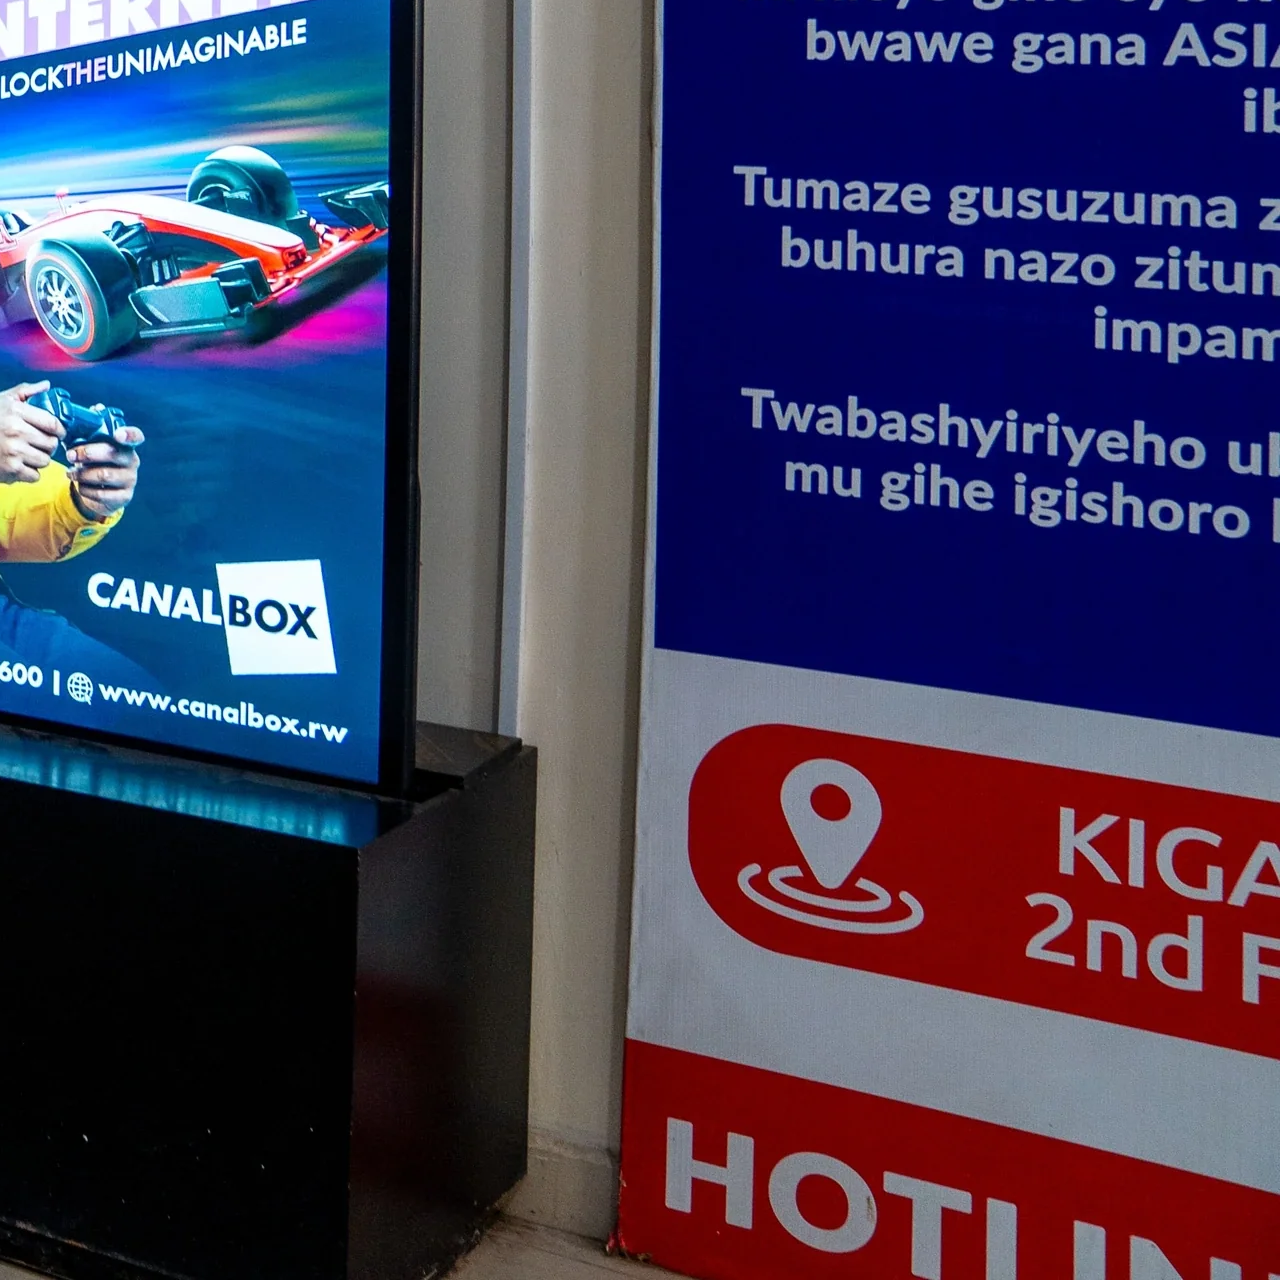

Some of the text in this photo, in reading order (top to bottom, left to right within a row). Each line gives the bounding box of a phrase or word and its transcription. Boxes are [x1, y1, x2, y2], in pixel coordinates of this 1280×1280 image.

[806, 18, 1280, 74] bwawe gana ASI
[733, 165, 932, 215] Tumaze
[948, 182, 1238, 230] gusuzuma
[780, 225, 964, 278] buhura
[984, 248, 1116, 286] nazo
[740, 387, 1206, 470] Twabashyiriyeho
[784, 459, 862, 499] mu
[880, 463, 995, 513] gihe
[1013, 472, 1251, 540] igishoro
[87, 572, 319, 640] CANALBOX
[98, 682, 348, 745] www.canalbox.rw
[1025, 891, 1204, 993] 2nd
